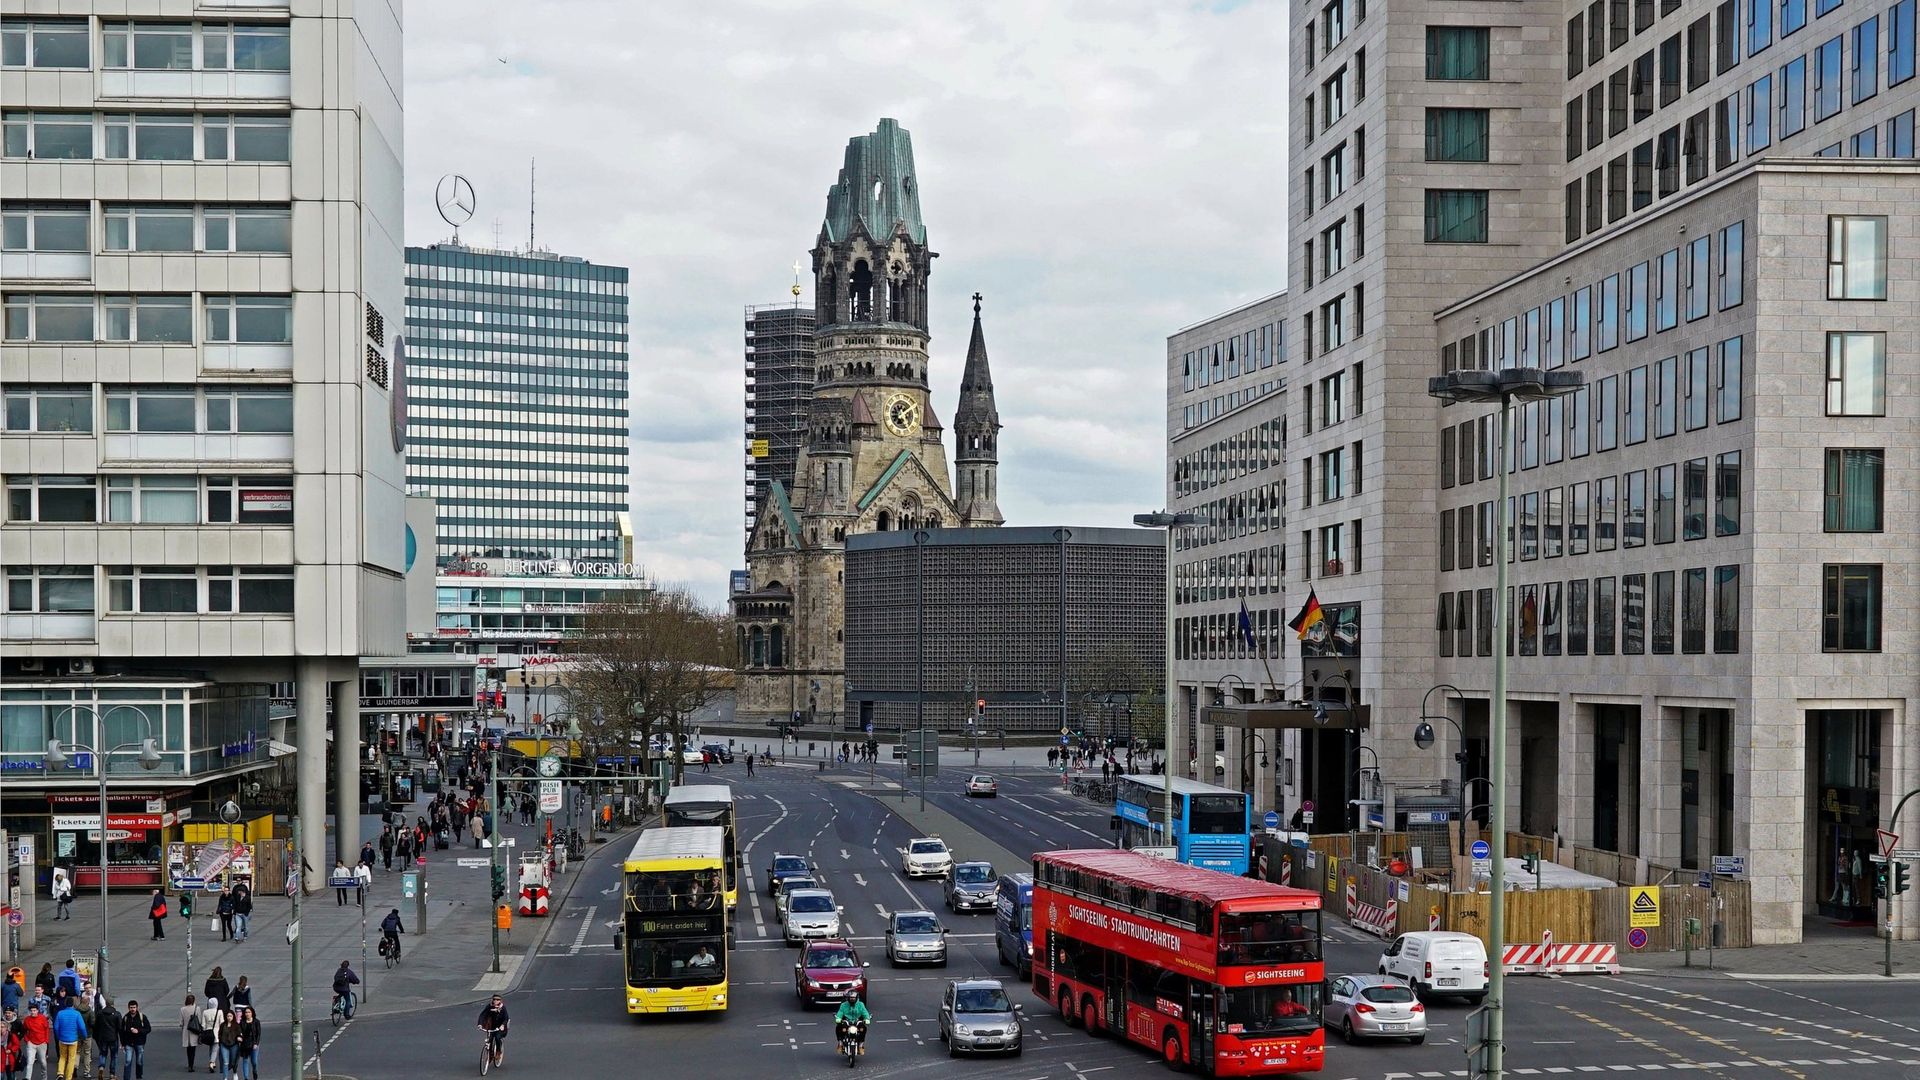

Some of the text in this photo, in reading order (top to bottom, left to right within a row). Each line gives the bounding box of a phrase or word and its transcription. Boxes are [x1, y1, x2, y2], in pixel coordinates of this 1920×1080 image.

[504, 558, 644, 577] BERLINER MORGENPOST
[482, 630, 495, 638] Die
[643, 921, 656, 932] 100
[656, 922, 673, 930] Fahrt
[675, 921, 693, 929] endet
[1068, 904, 1181, 952] SIGHTSEEING STADTRUNDFAHRTEN
[1257, 969, 1305, 979] SIGHTSEEING
